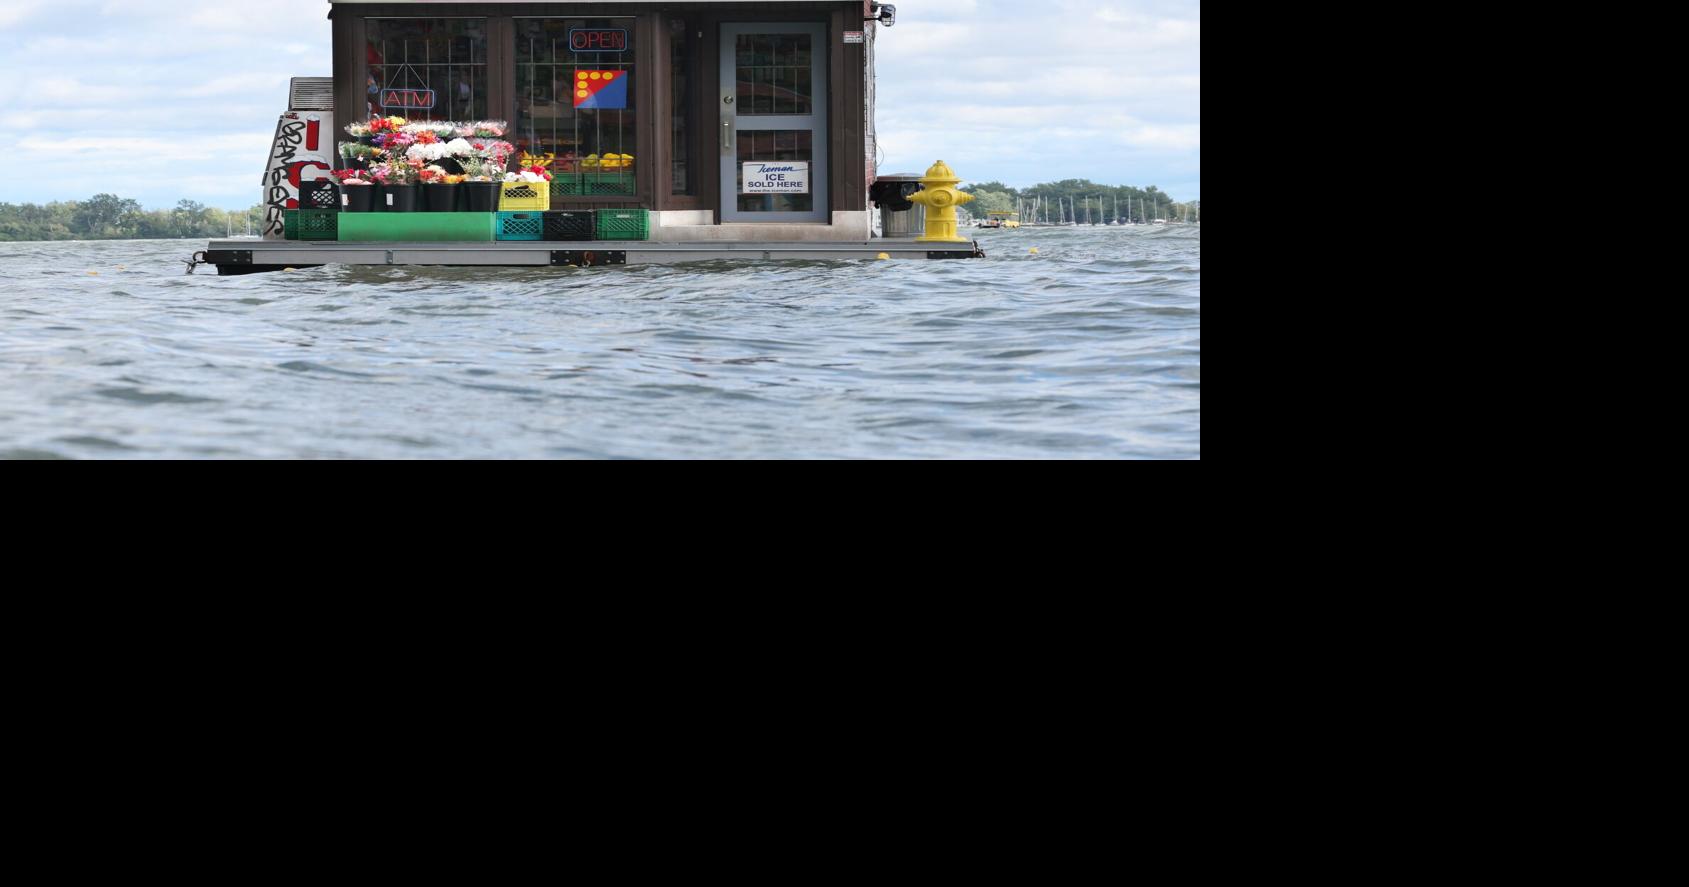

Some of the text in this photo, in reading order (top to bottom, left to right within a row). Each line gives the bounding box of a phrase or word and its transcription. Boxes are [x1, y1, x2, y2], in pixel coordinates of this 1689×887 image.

[572, 31, 624, 48] OPEN
[384, 90, 430, 106] ATM
[745, 164, 807, 173] Iceman
